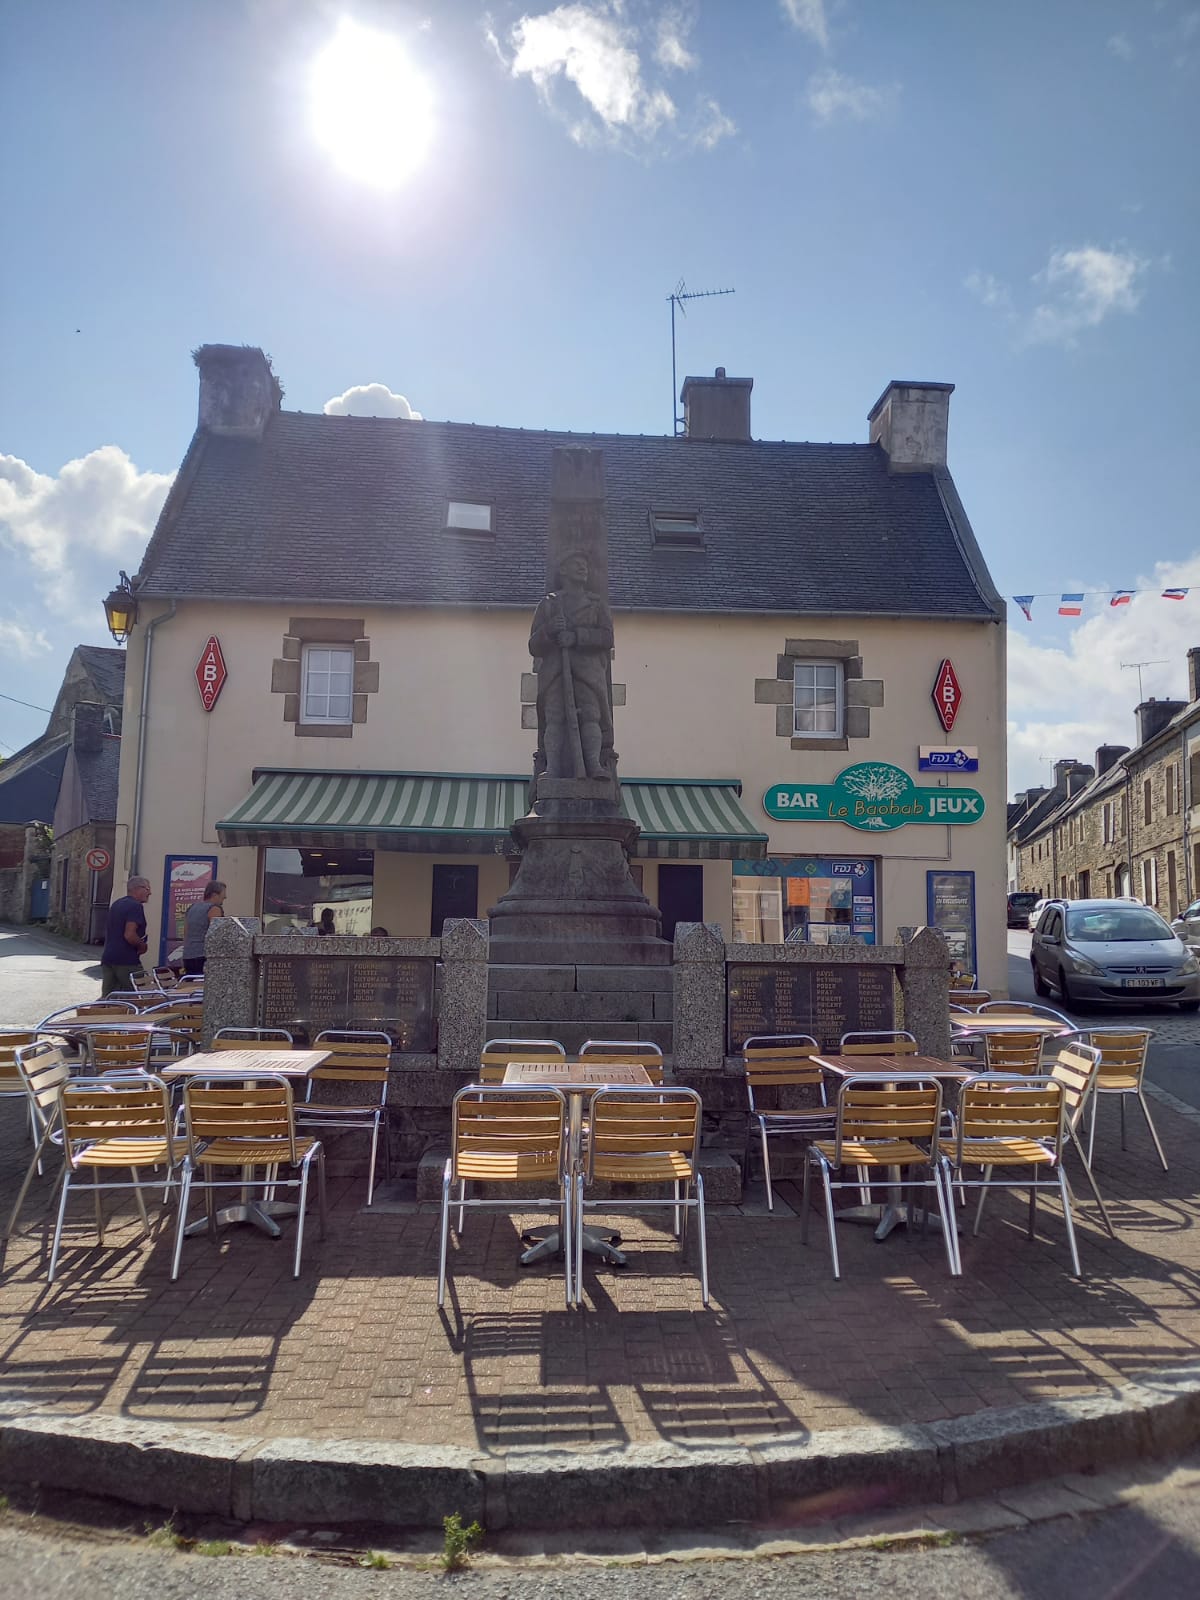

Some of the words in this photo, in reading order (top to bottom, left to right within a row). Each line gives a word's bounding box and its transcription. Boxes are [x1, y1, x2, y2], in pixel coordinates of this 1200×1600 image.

[203, 642, 217, 704] TABAC
[942, 665, 956, 724] TABAC
[931, 754, 949, 763] FDJ
[777, 792, 819, 808] BAR
[827, 801, 848, 817] Le
[854, 799, 924, 816] Baobab
[928, 797, 979, 817] JEUX
[834, 865, 851, 873] FDJ
